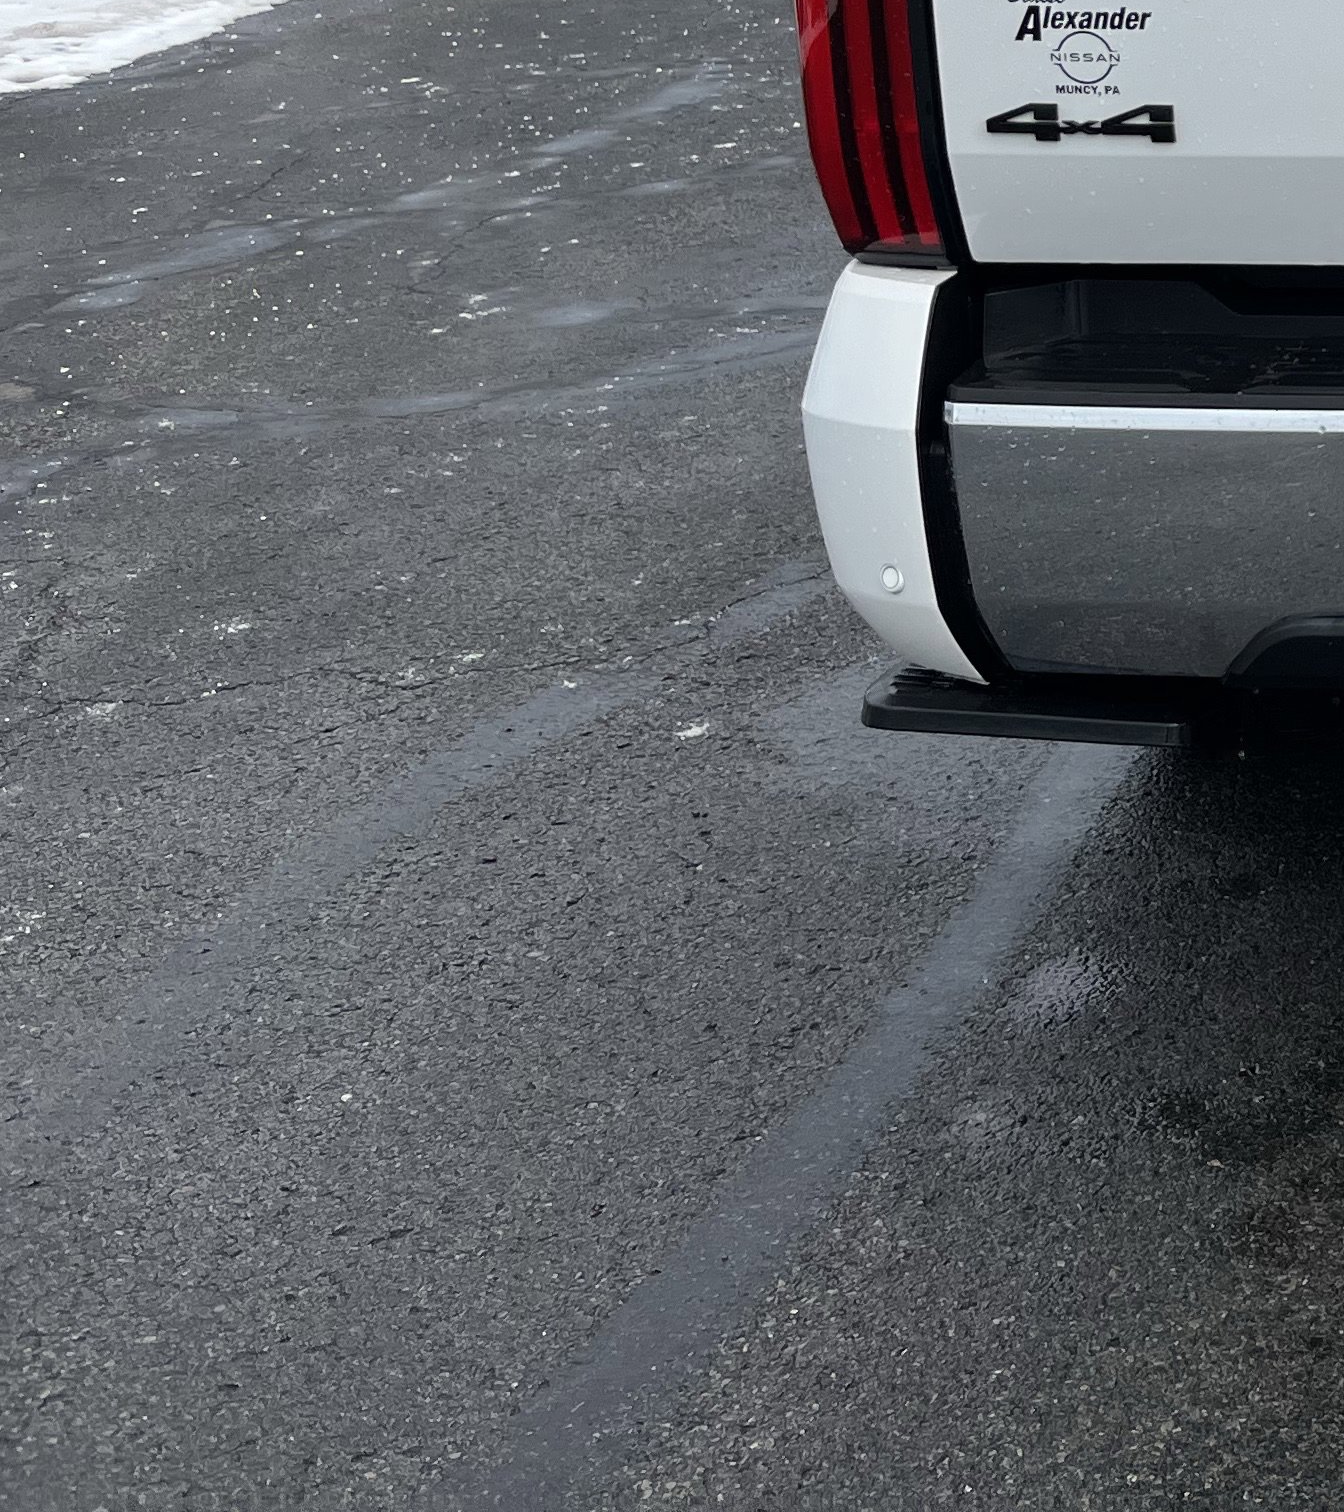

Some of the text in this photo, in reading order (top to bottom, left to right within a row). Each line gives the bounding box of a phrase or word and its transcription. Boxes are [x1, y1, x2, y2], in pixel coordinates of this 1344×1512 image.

[1014, 5, 1153, 42] Alexander
[1050, 51, 1121, 64] NISSAN
[1055, 84, 1121, 97] MUNCY, PA
[985, 102, 1177, 144] 4x4
